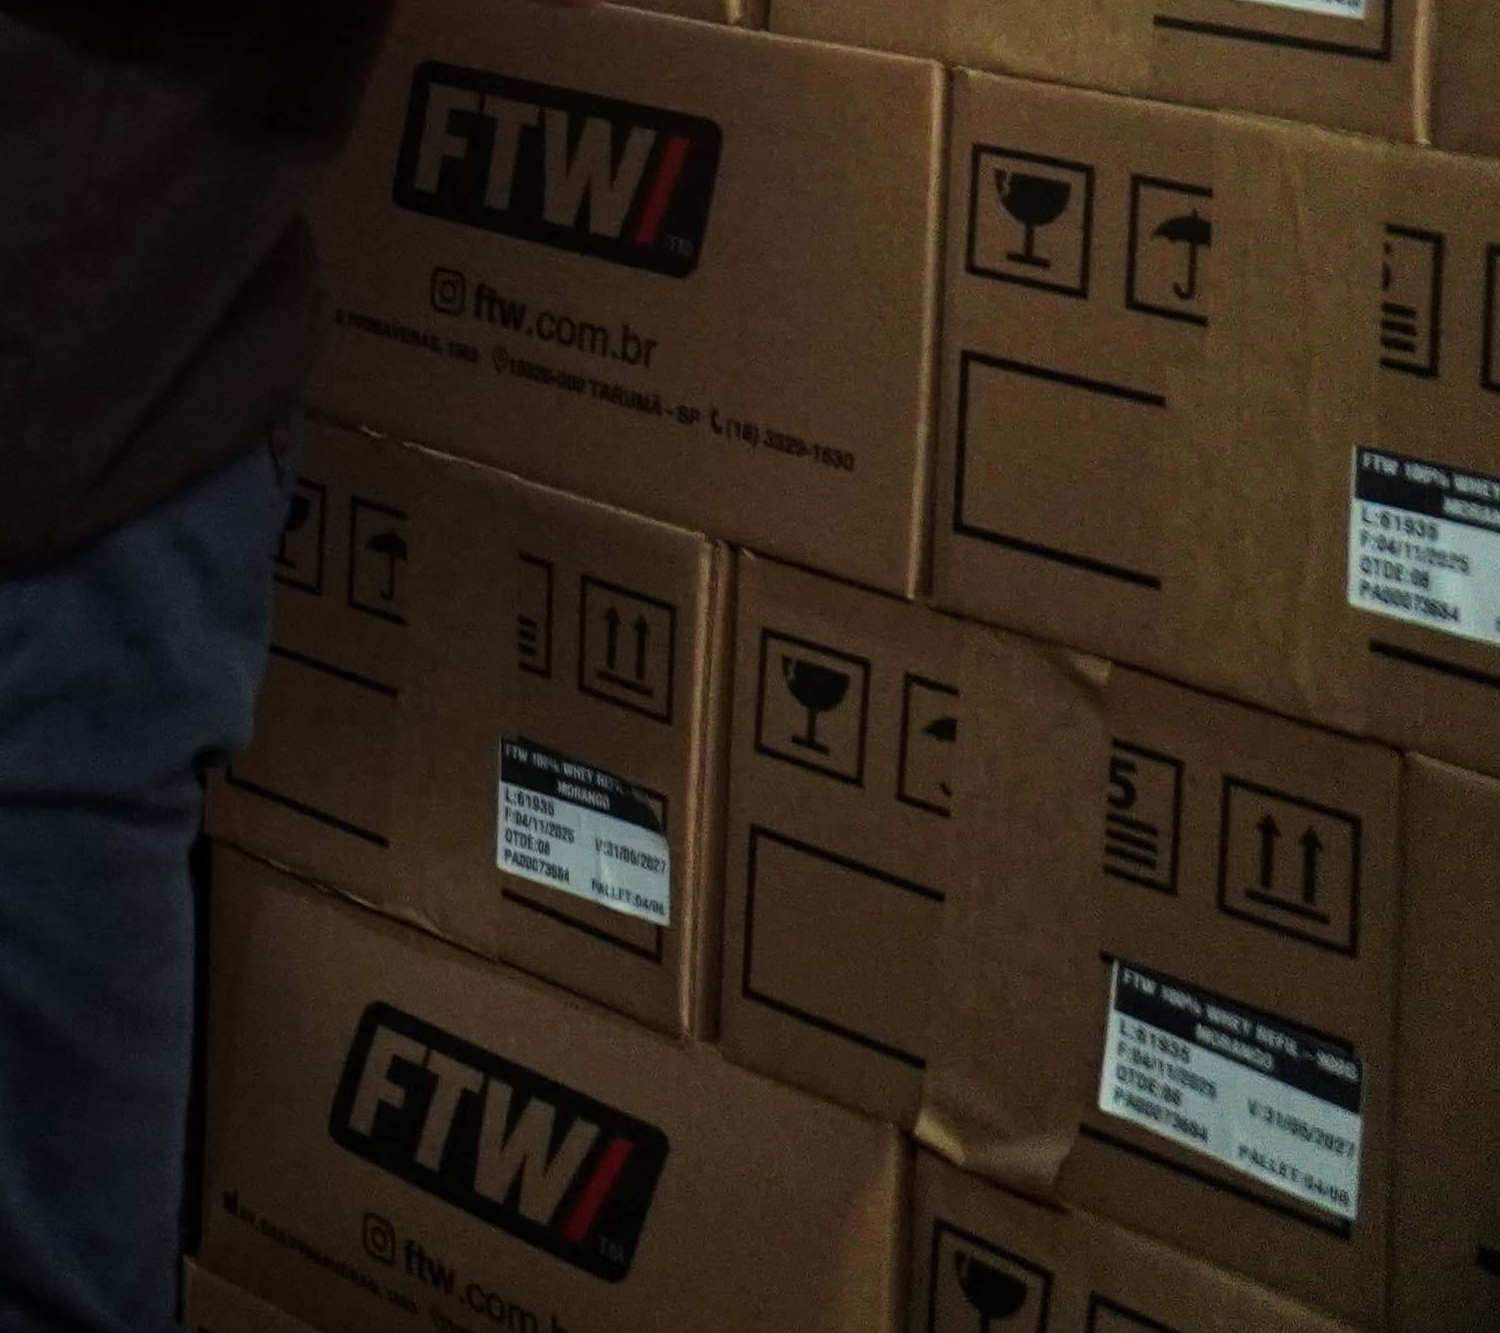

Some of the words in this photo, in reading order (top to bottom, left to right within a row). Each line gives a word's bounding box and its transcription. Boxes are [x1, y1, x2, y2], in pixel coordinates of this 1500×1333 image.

[414, 81, 659, 239] FTW
[473, 282, 658, 371] ftw.com.br
[677, 402, 700, 426] SP
[506, 744, 527, 762] FTW
[564, 762, 592, 781] WHEY
[505, 788, 555, 817] L:61935
[557, 781, 610, 811] MORANGO
[505, 807, 575, 844] F:04/11/2025
[505, 829, 550, 856] QTDE:08
[596, 838, 666, 875] V:31/05/2027
[348, 1025, 600, 1226] FTW
